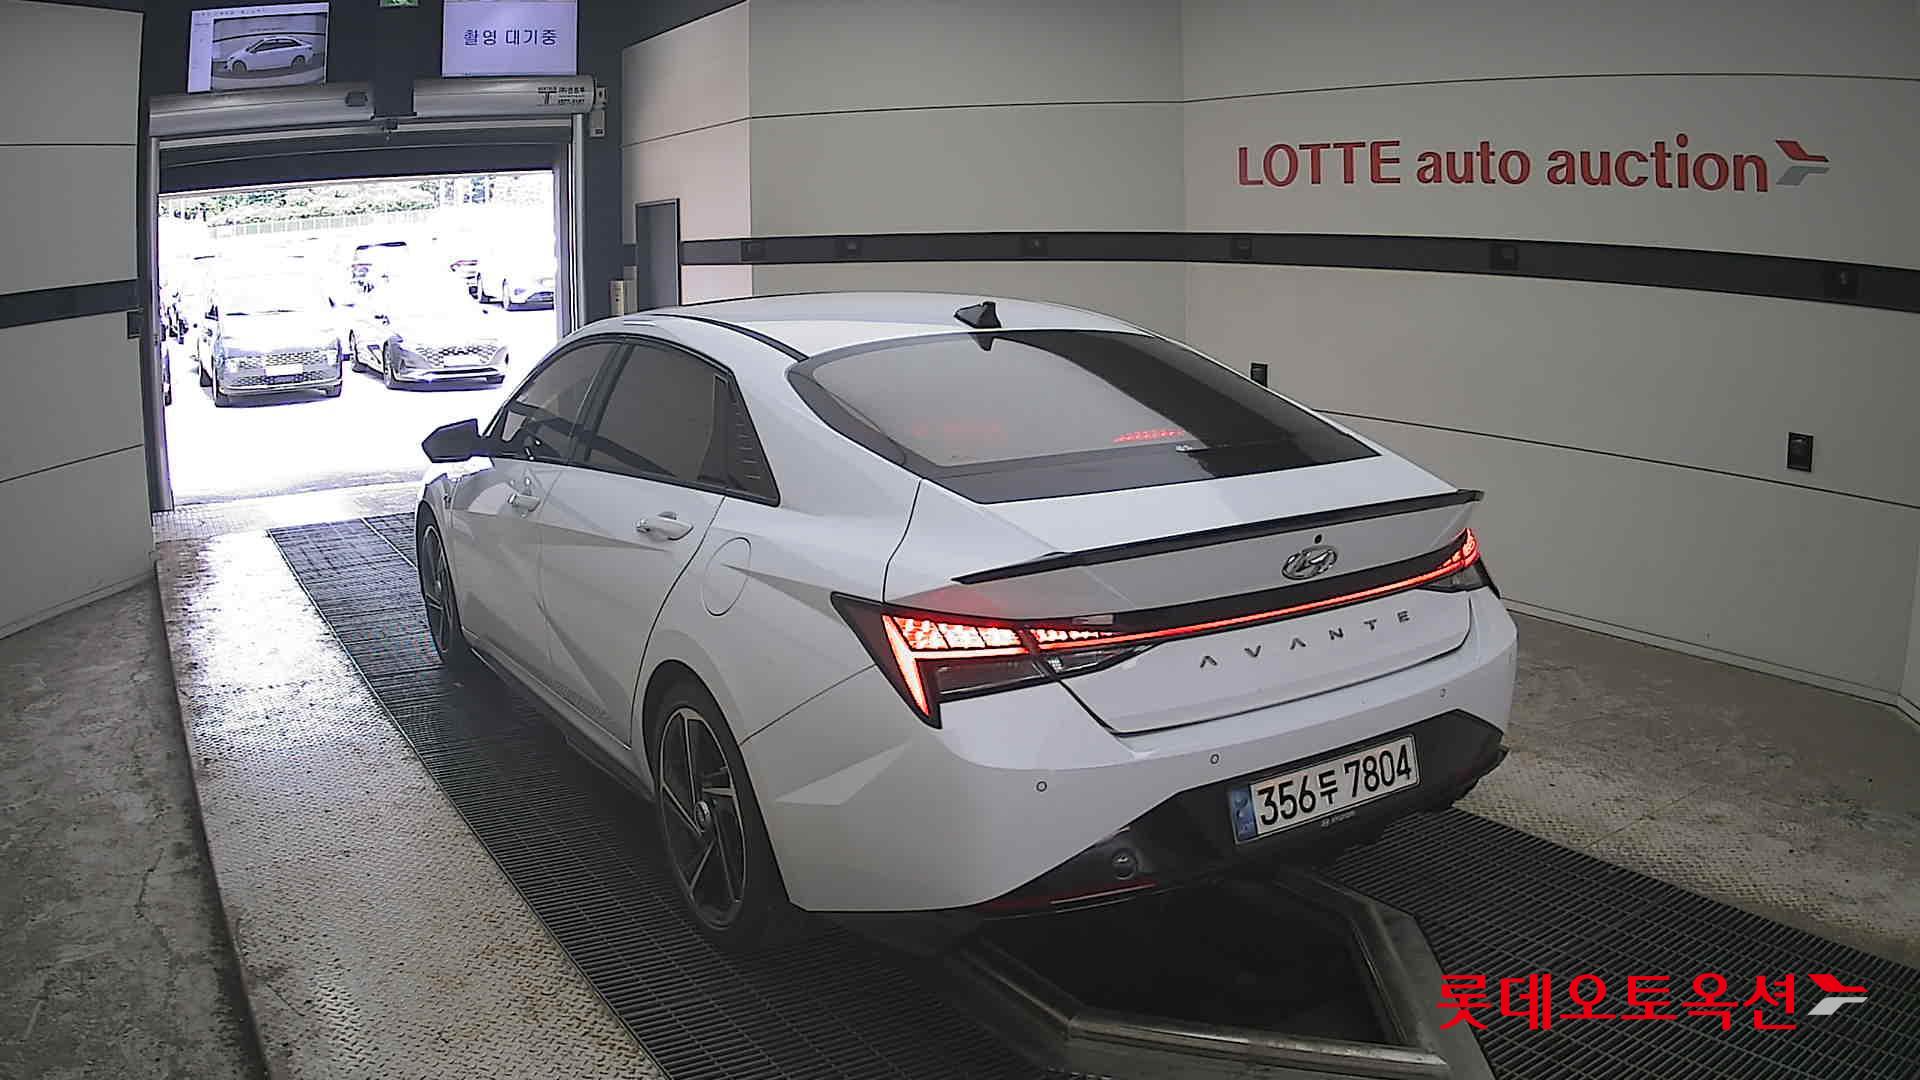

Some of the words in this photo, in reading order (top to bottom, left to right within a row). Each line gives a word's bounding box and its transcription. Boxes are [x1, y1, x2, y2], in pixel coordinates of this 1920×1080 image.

[505, 29, 559, 46] 대기중
[1238, 140, 1400, 187] LOTTE
[1416, 141, 1532, 185] auto
[1547, 133, 1769, 192] auction
[1200, 610, 1411, 668] AVANTE
[1344, 744, 1412, 798] 7804
